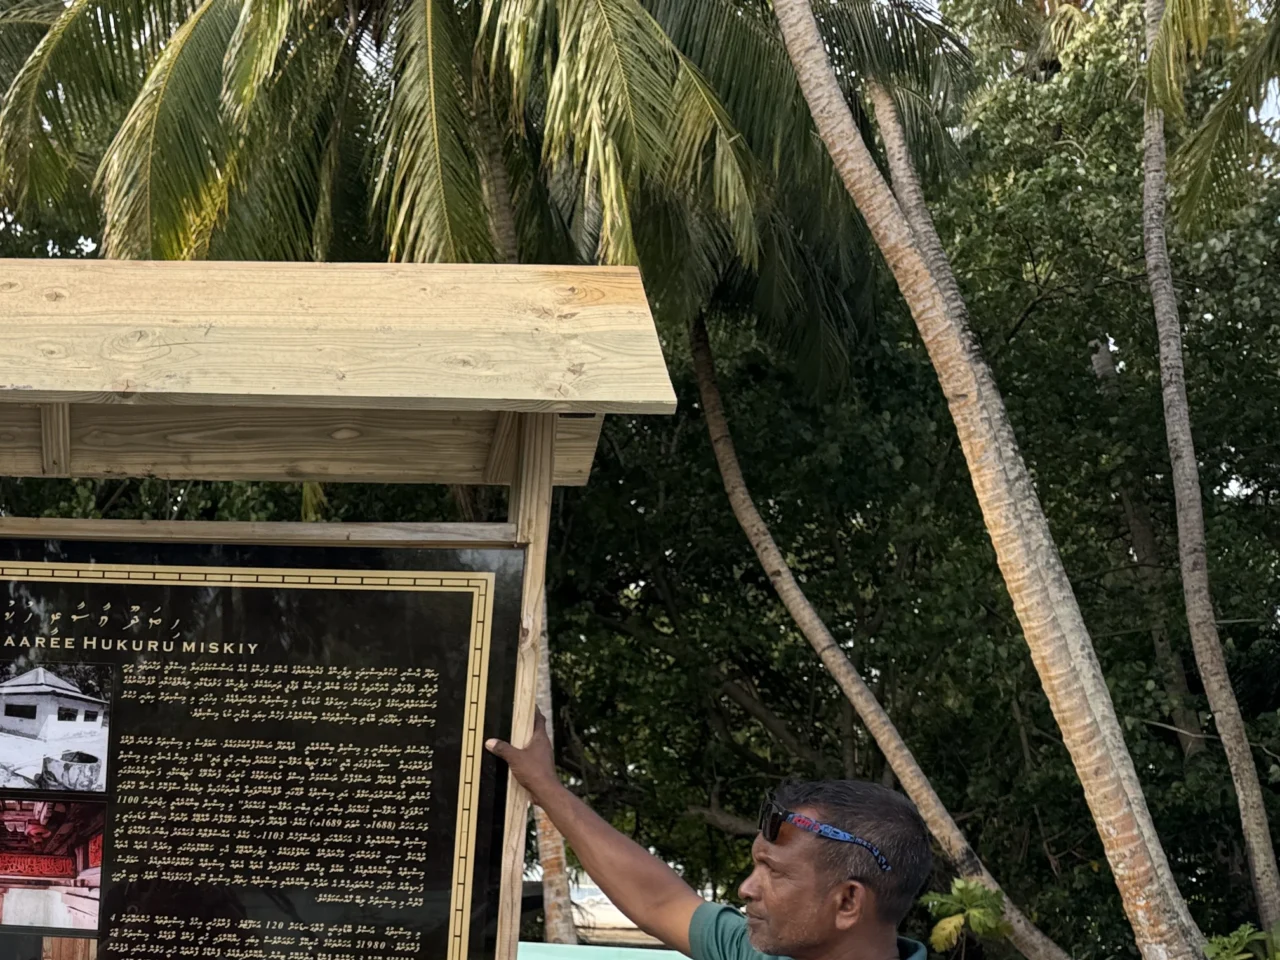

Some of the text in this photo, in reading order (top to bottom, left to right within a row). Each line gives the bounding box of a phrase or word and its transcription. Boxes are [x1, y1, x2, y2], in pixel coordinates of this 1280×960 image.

[84, 636, 175, 651] HUKURU
[183, 642, 258, 654] MISKIY
[117, 795, 139, 803] 1100
